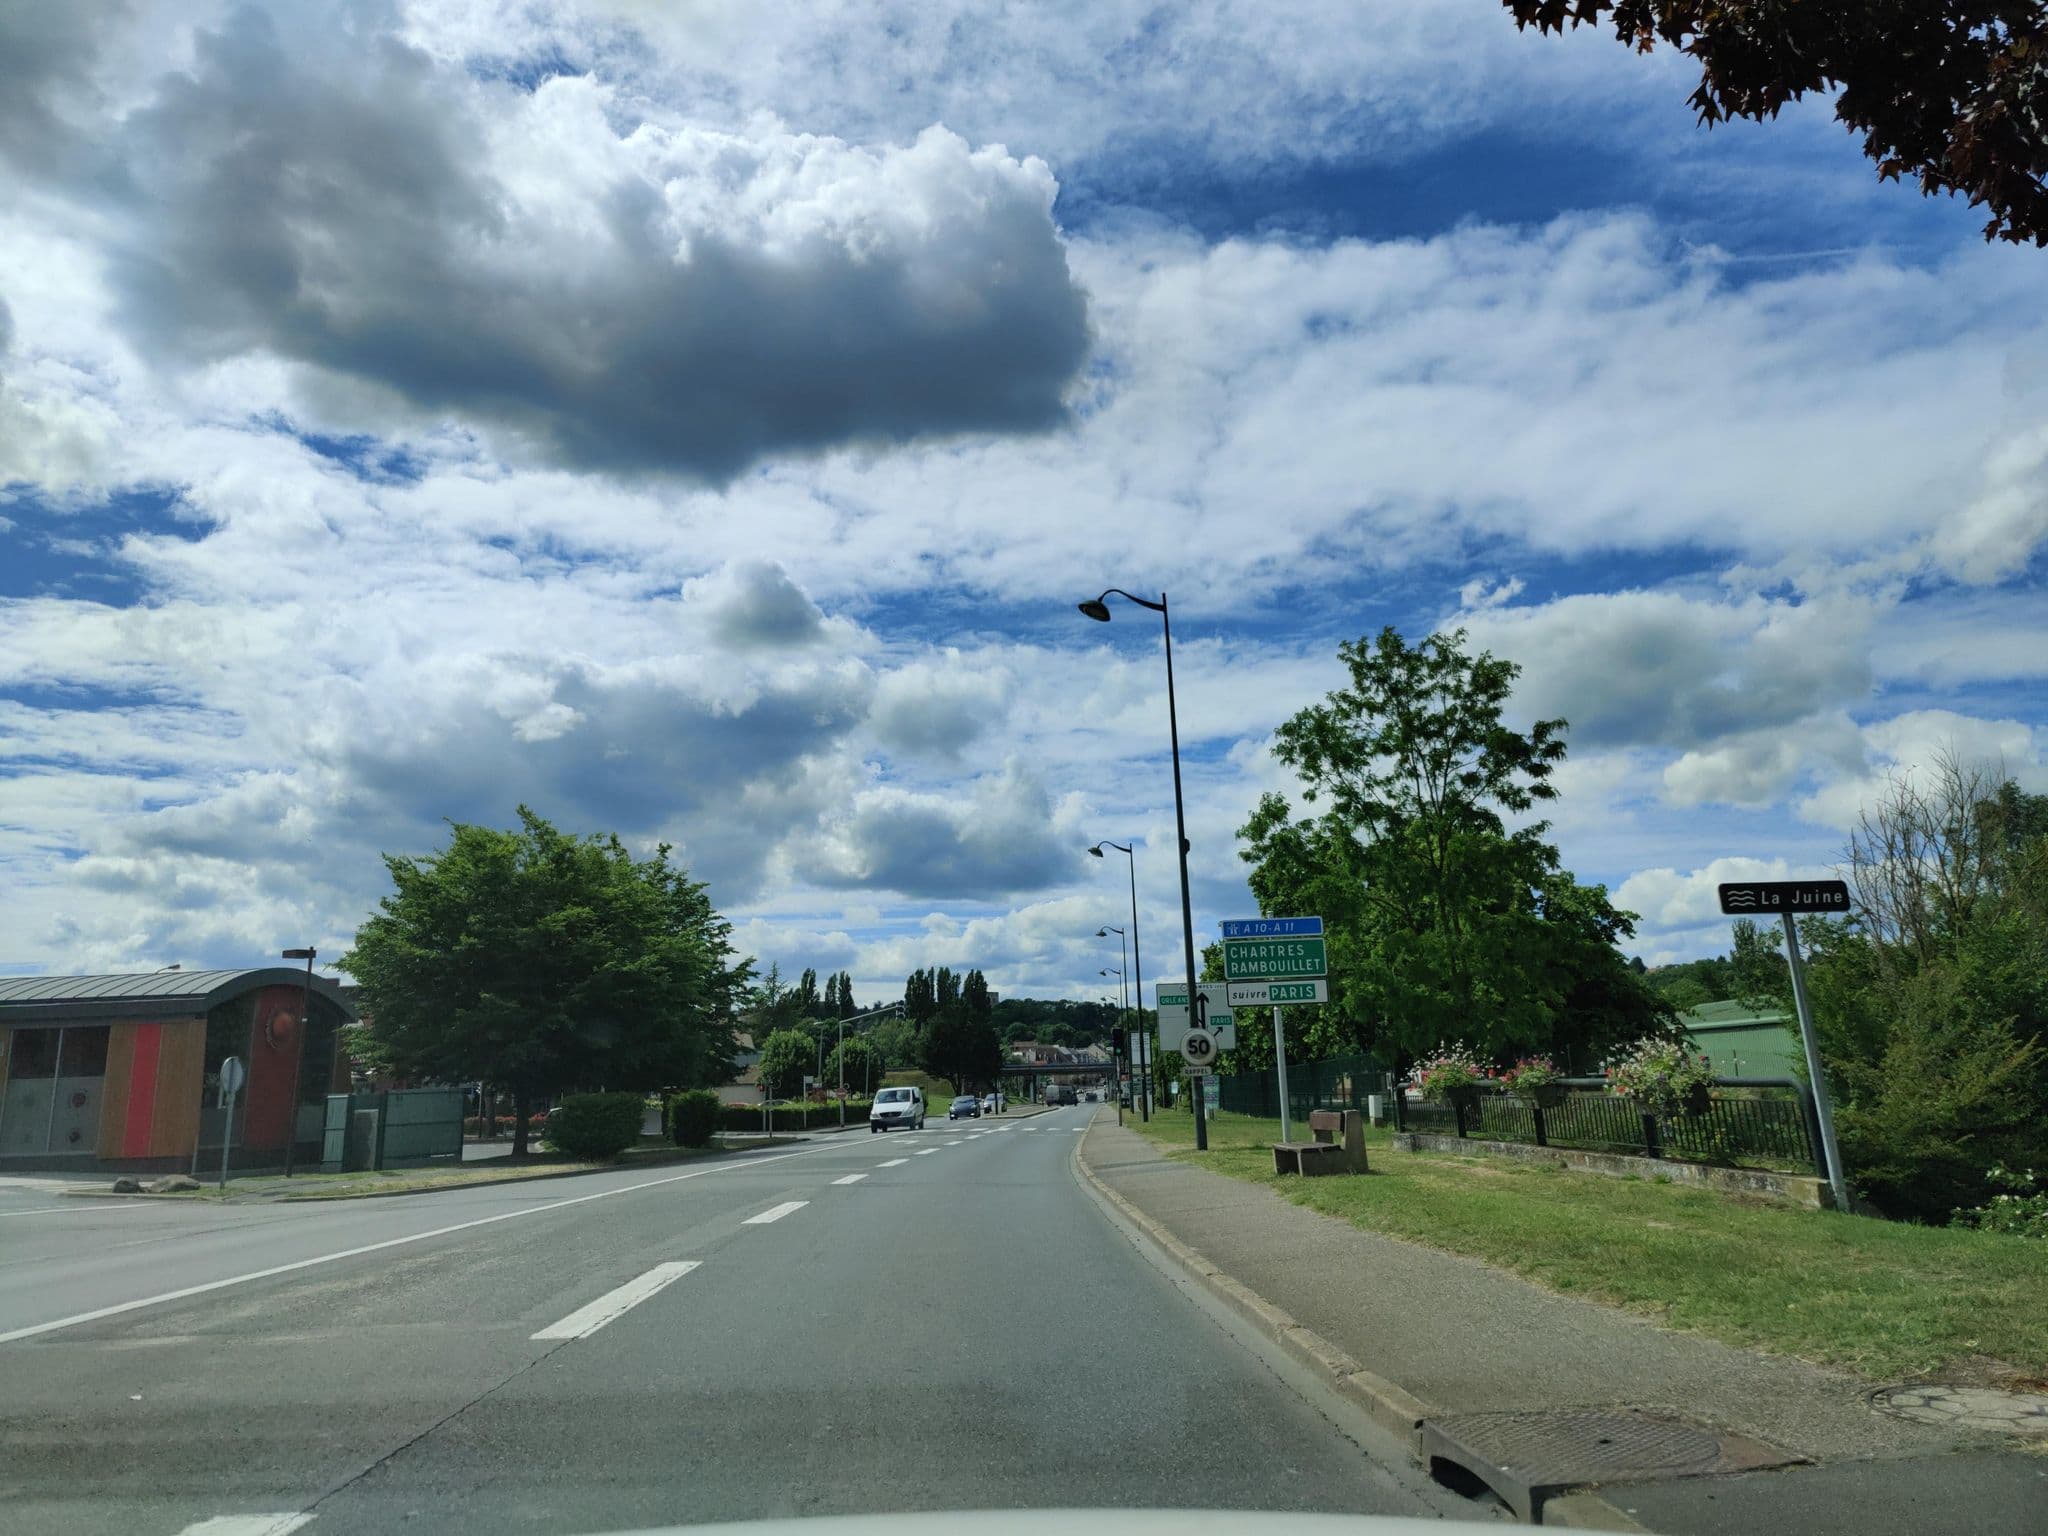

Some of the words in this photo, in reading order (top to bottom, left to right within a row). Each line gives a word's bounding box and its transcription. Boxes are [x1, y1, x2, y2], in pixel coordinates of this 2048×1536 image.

[1761, 891, 1780, 905] La
[1791, 889, 1843, 904] Juine
[1230, 944, 1304, 959] CHARTRES
[1231, 959, 1320, 974] RAMBOUILLET
[1232, 990, 1267, 1000] suivre
[1271, 986, 1314, 999] PARIS
[1188, 1039, 1210, 1055] 50
